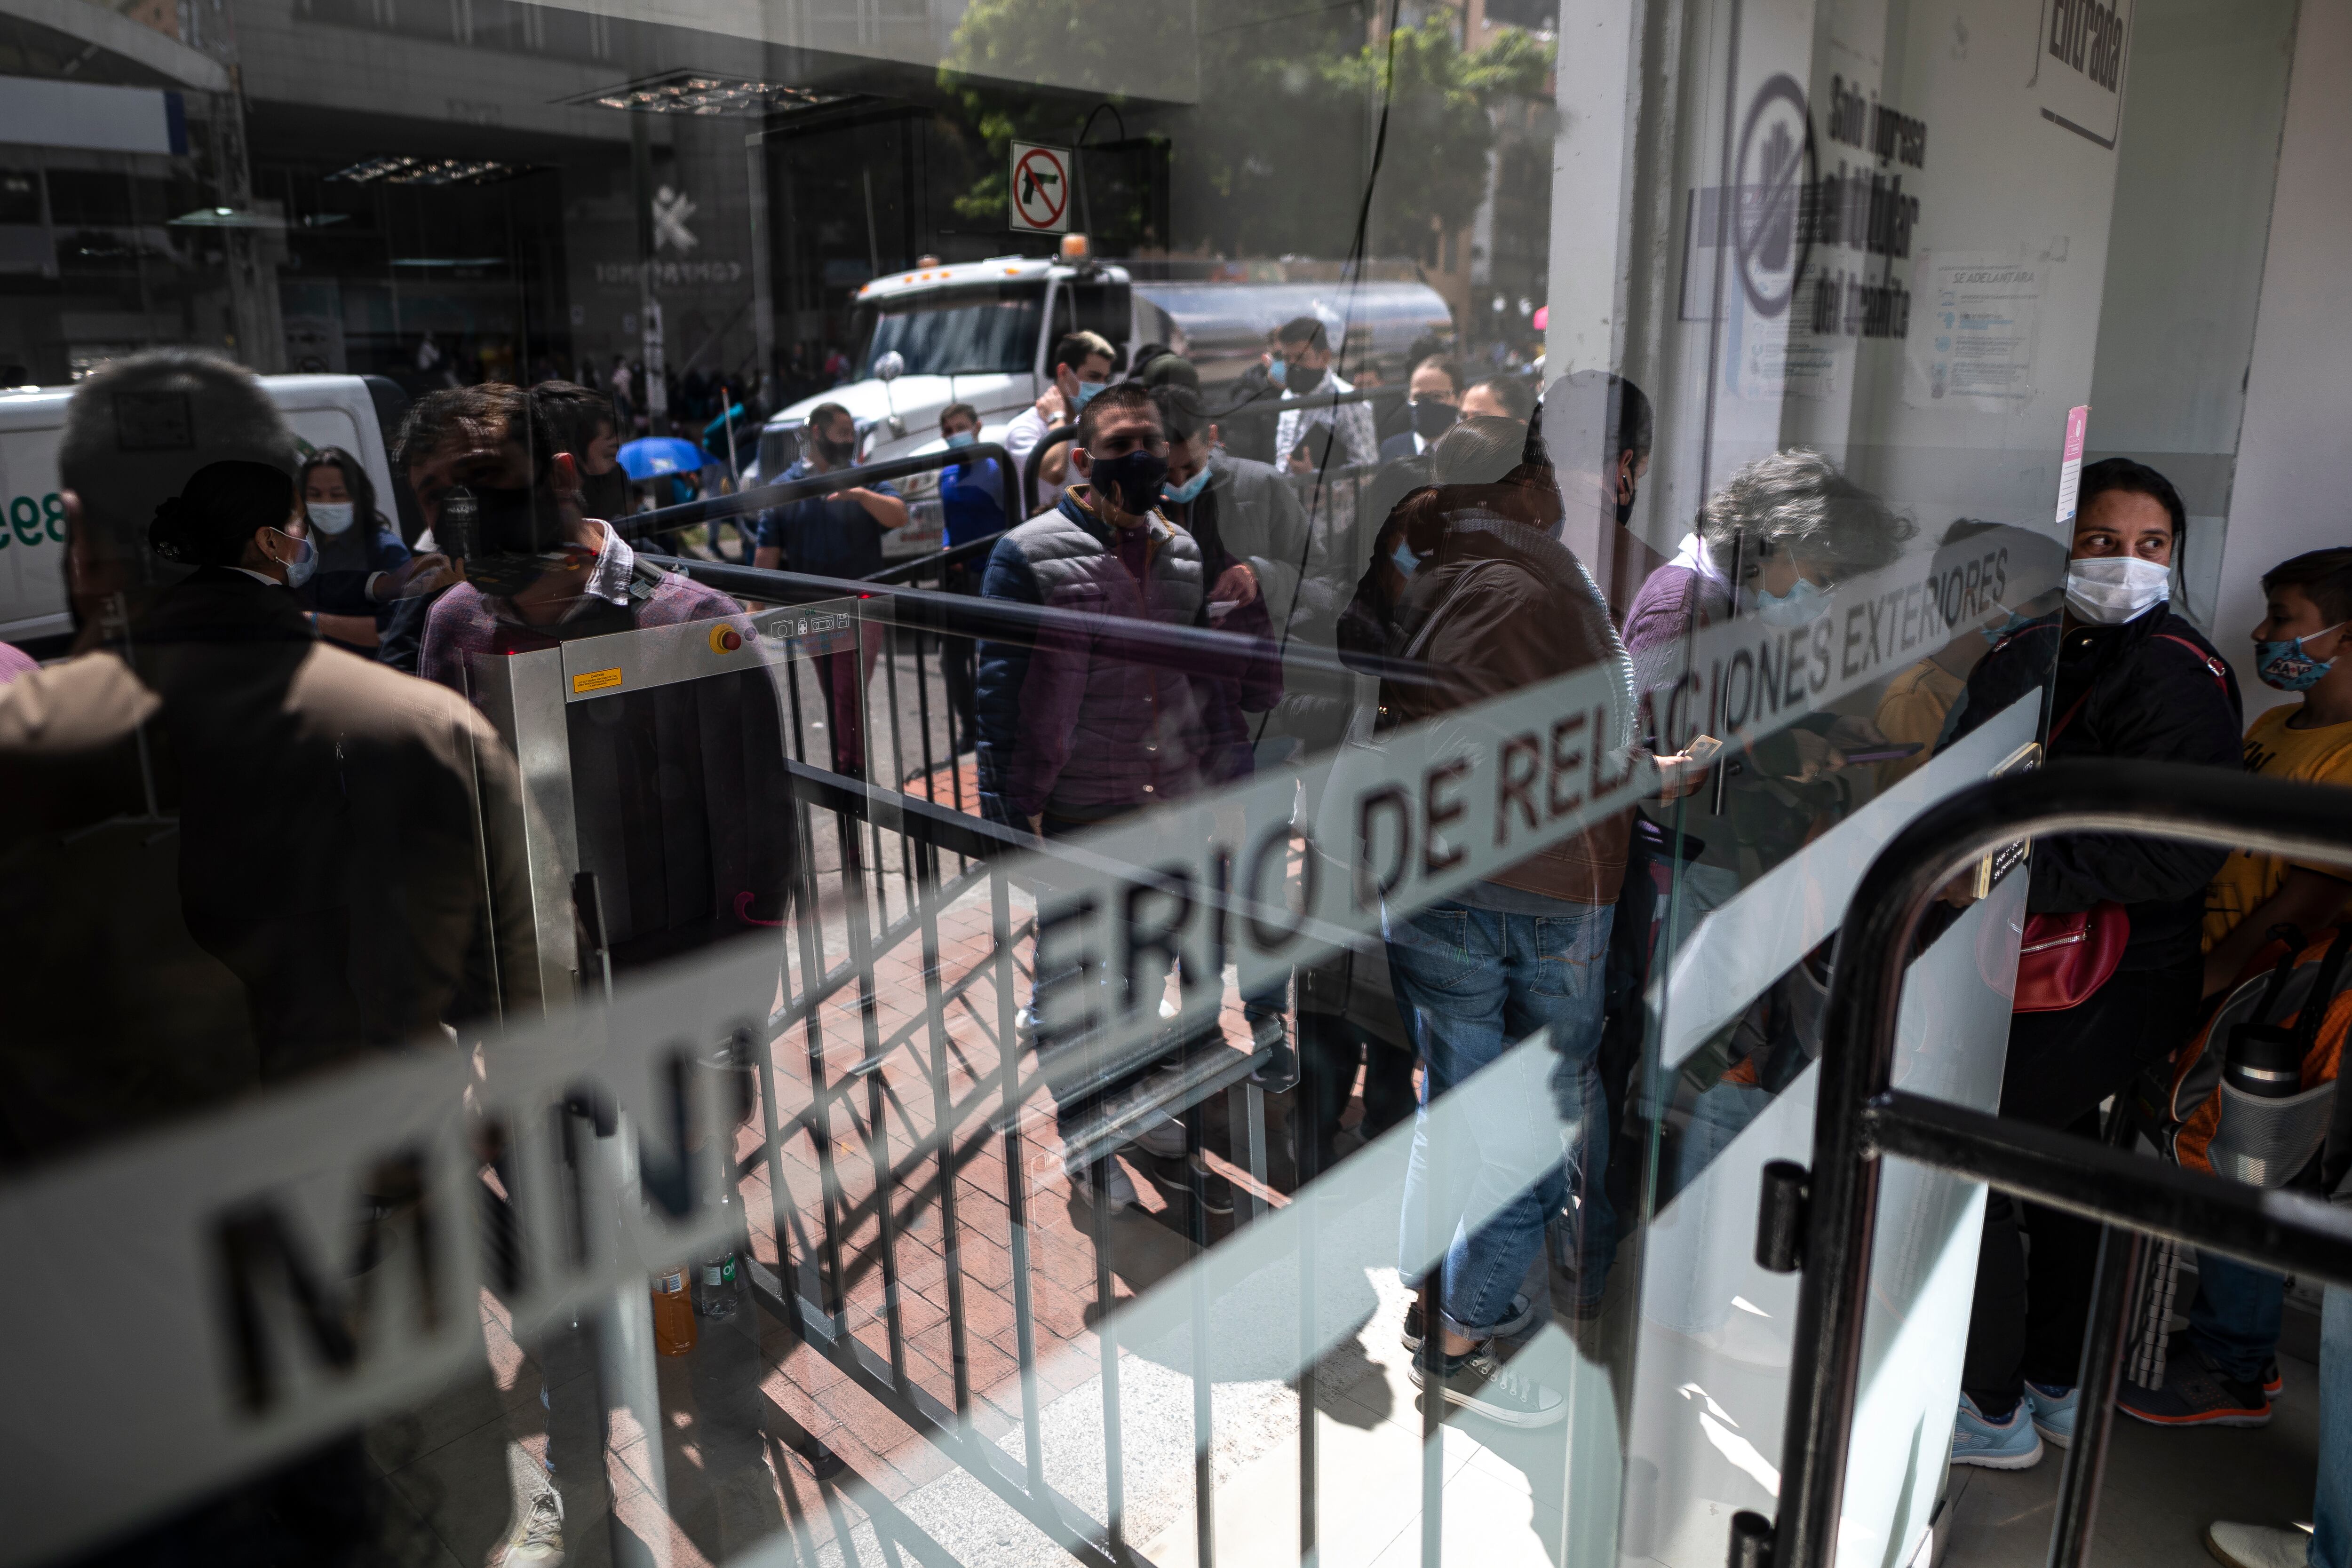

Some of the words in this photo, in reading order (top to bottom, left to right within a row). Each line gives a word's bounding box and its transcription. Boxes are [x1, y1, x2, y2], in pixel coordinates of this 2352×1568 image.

[2049, 0, 2123, 94] Entrada
[1351, 756, 1471, 912] DE
[1840, 546, 2009, 683] EXTERIORES
